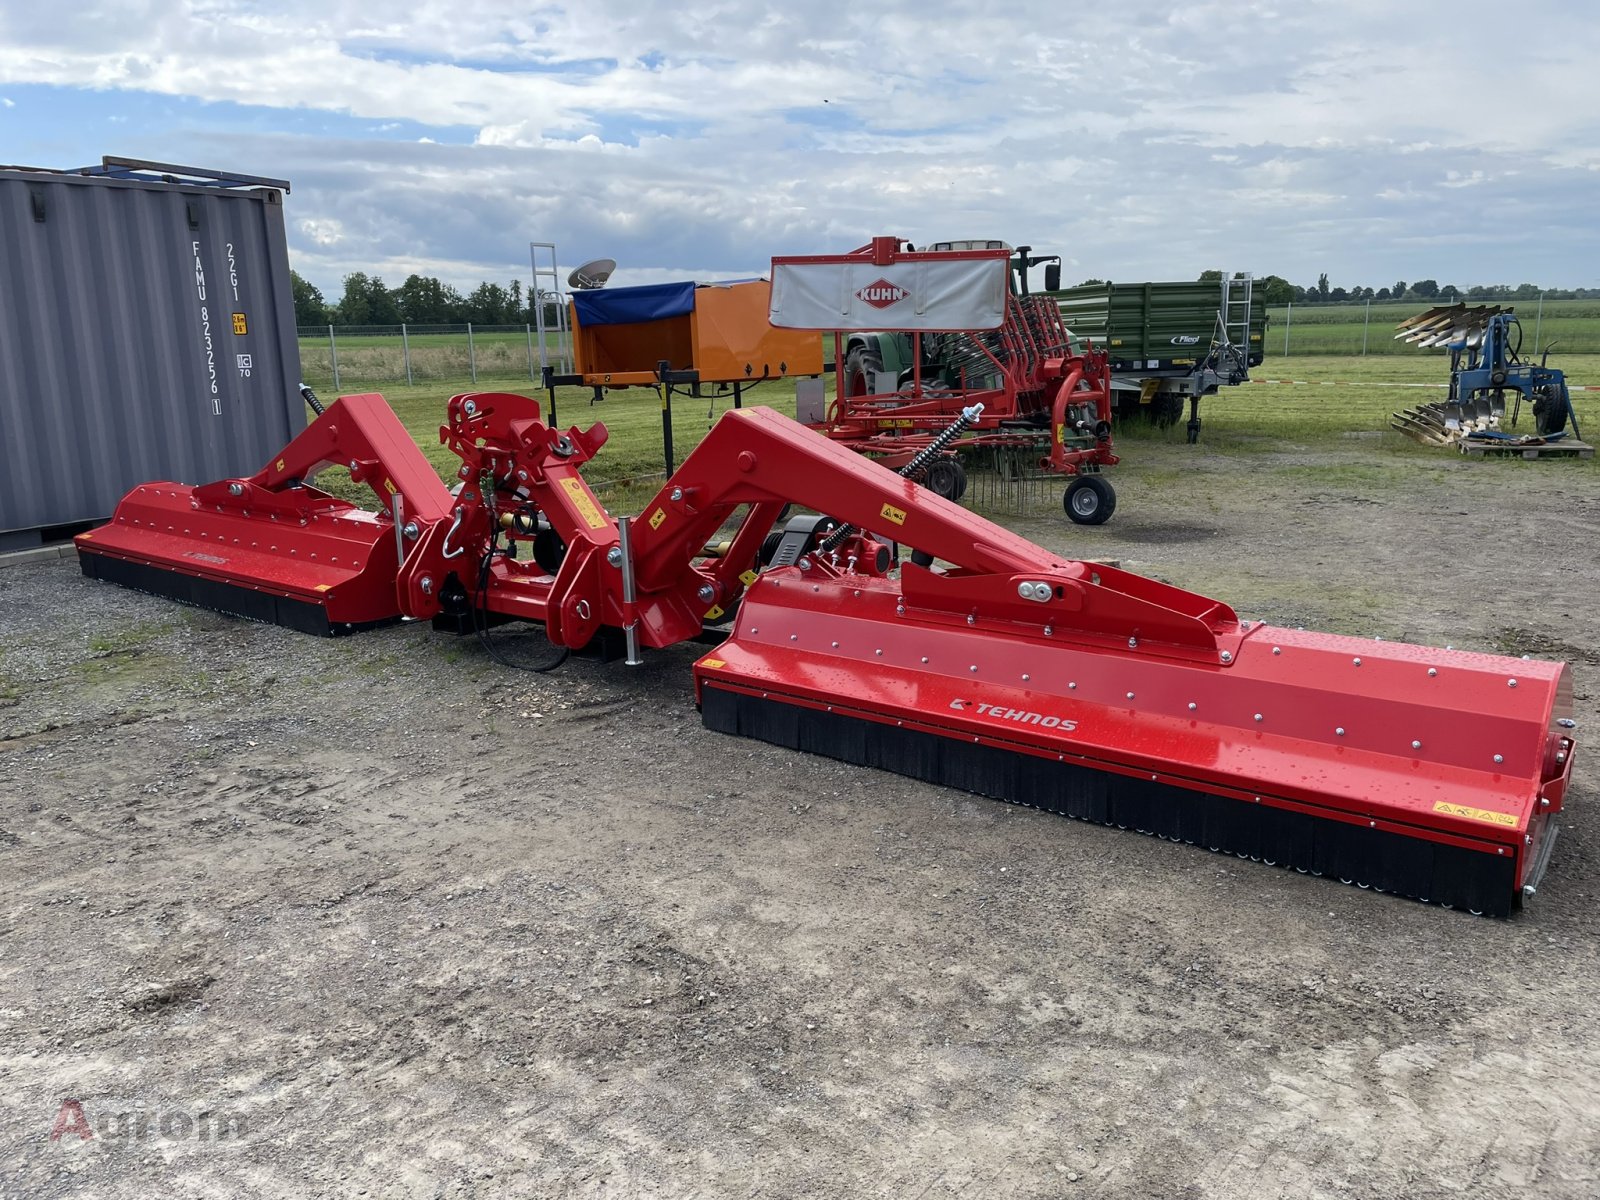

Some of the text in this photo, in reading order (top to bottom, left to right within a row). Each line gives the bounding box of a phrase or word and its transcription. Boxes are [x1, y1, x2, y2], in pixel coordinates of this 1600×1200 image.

[226, 243, 239, 301] 22G1
[860, 287, 904, 301] KUHN
[192, 241, 206, 301] FAMU
[201, 306, 218, 394] 823256
[240, 369, 251, 377] 70
[976, 703, 1079, 731] TEHNOS
